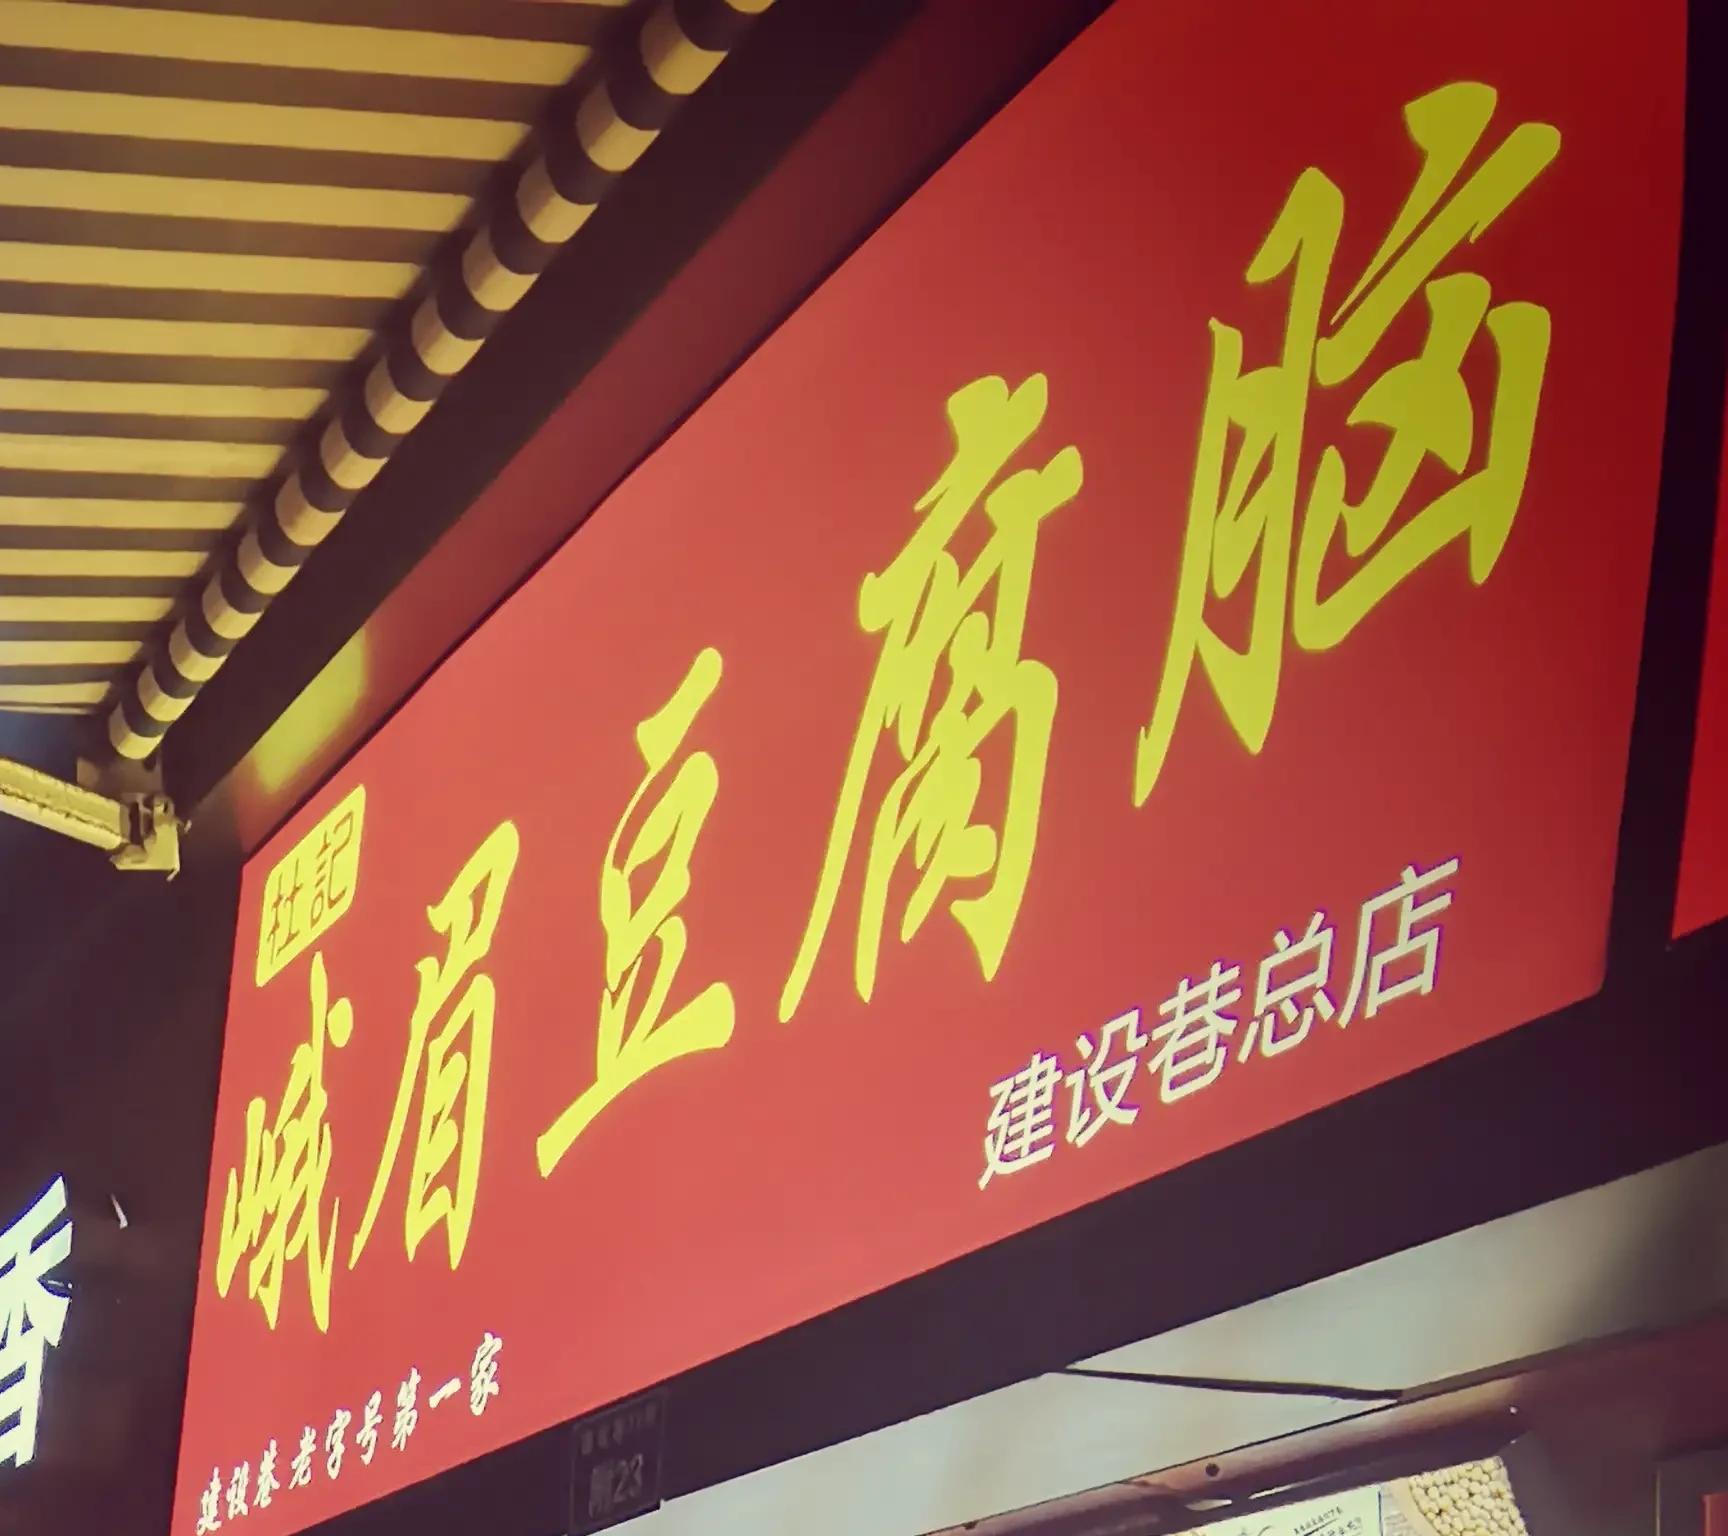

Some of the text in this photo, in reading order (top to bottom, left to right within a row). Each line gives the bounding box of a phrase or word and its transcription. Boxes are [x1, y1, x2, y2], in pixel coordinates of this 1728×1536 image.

[215, 80, 1563, 1334] 峨眉豆腐脑
[978, 857, 1460, 1189] 建设巷总店
[196, 1331, 504, 1536] 建设巷老字号第一家
